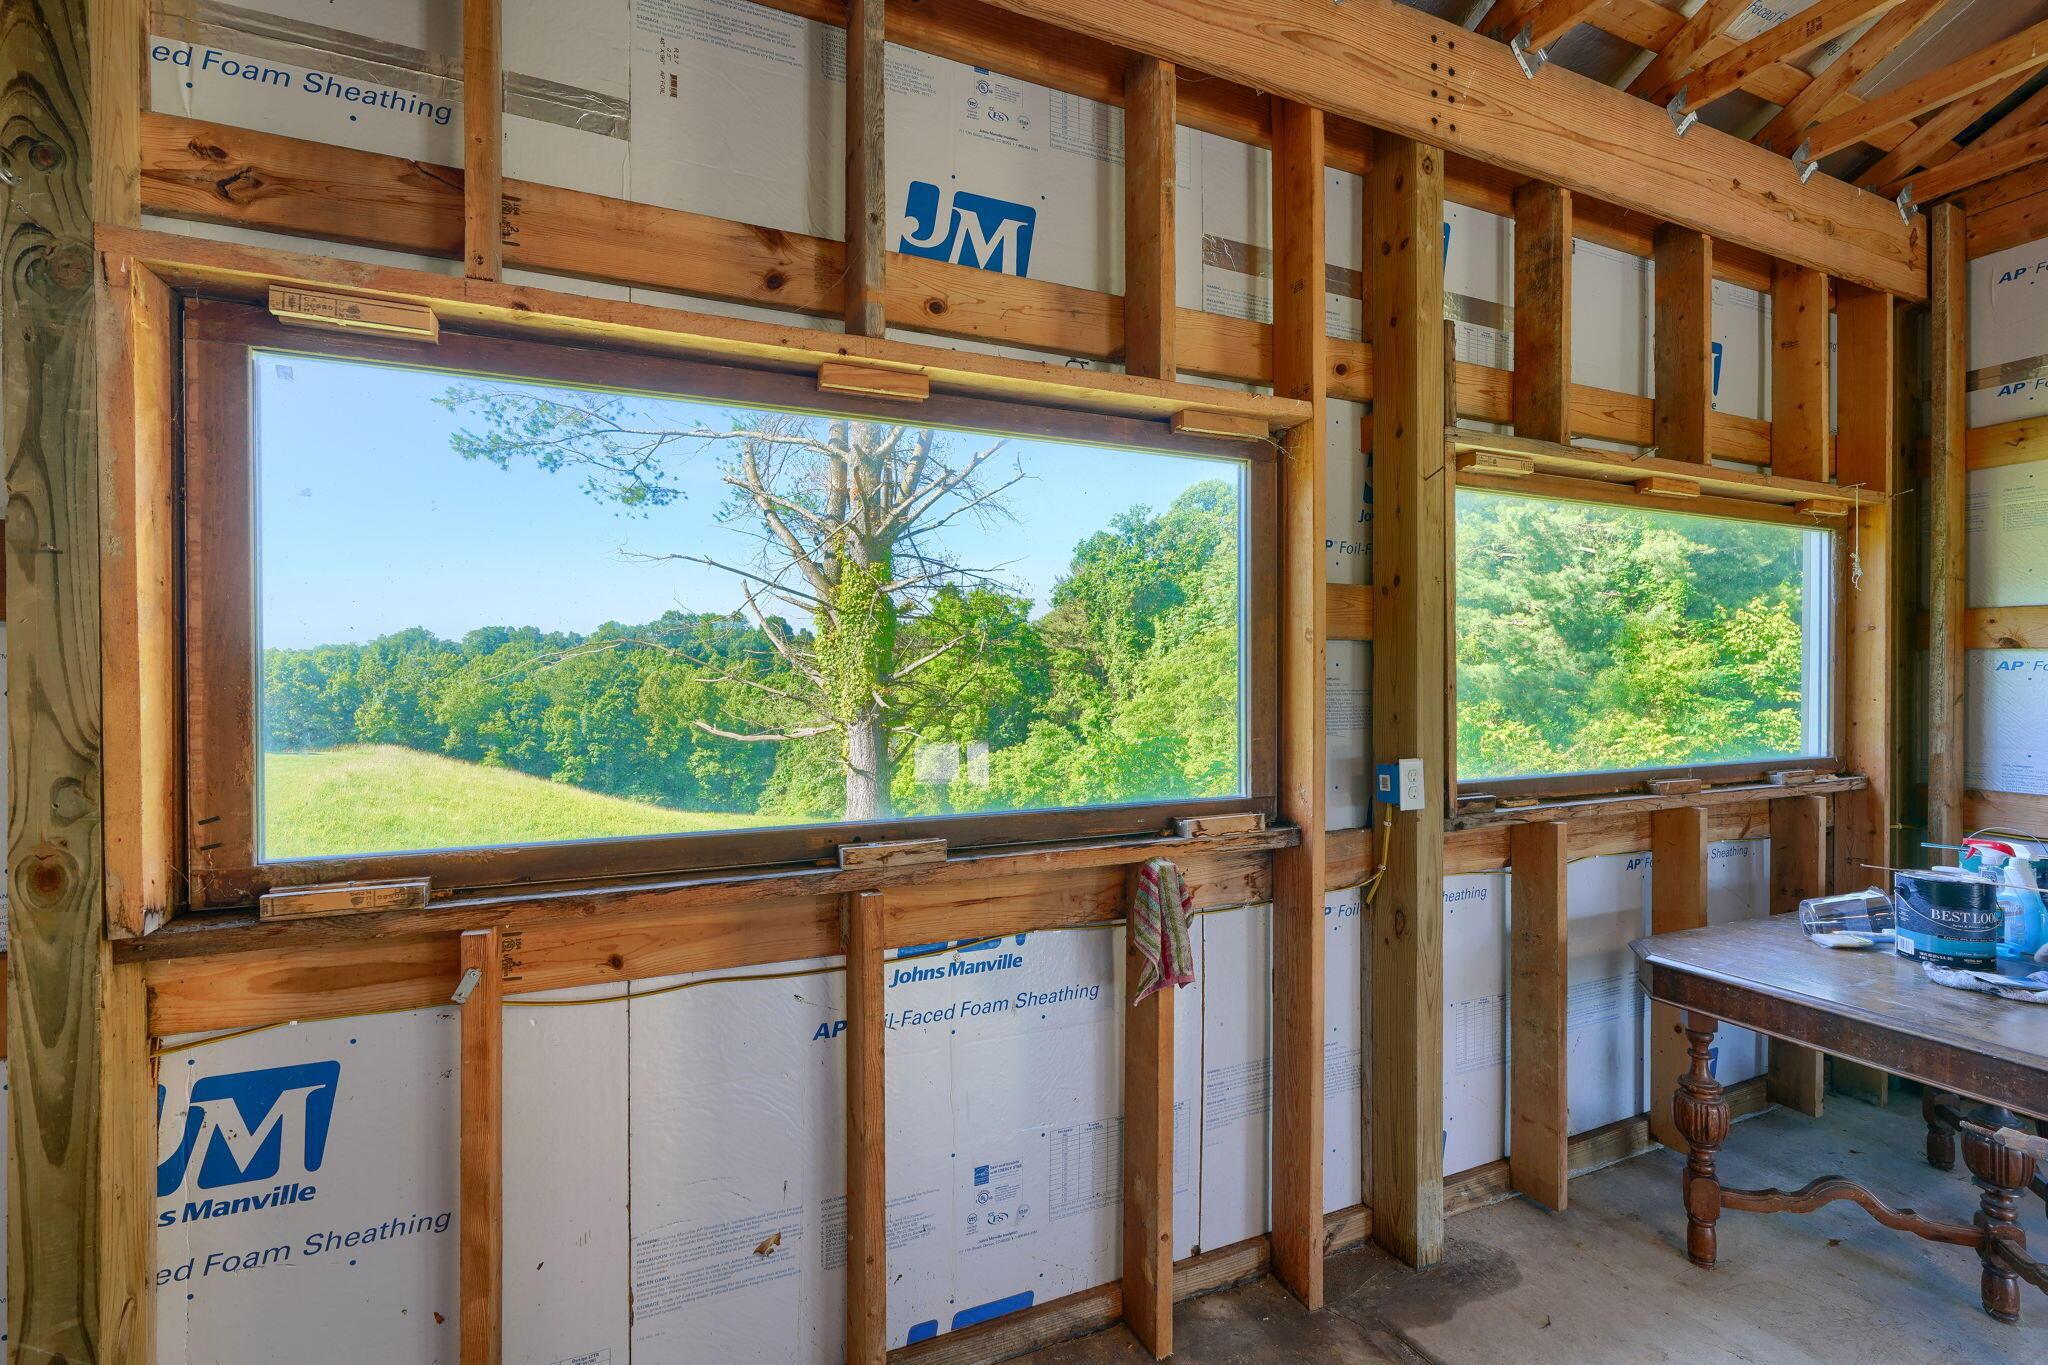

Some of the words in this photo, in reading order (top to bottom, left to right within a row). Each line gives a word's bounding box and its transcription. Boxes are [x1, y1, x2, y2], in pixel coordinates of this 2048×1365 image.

[202, 50, 290, 88] Foam
[303, 73, 452, 126] Sheathing
[900, 180, 1036, 278] JM
[1995, 660, 2024, 671] AP
[1711, 845, 1749, 860] Sheathing
[1930, 908, 1971, 925] BEST
[889, 965, 945, 988] Johns
[948, 953, 1023, 977] Manville
[960, 997, 1009, 1017] Foam
[1015, 983, 1100, 1009] Sheathing
[813, 1020, 847, 1040] AP
[181, 1183, 316, 1222] Manville
[203, 1244, 291, 1277] Foam
[303, 1211, 452, 1256] Sheathing
